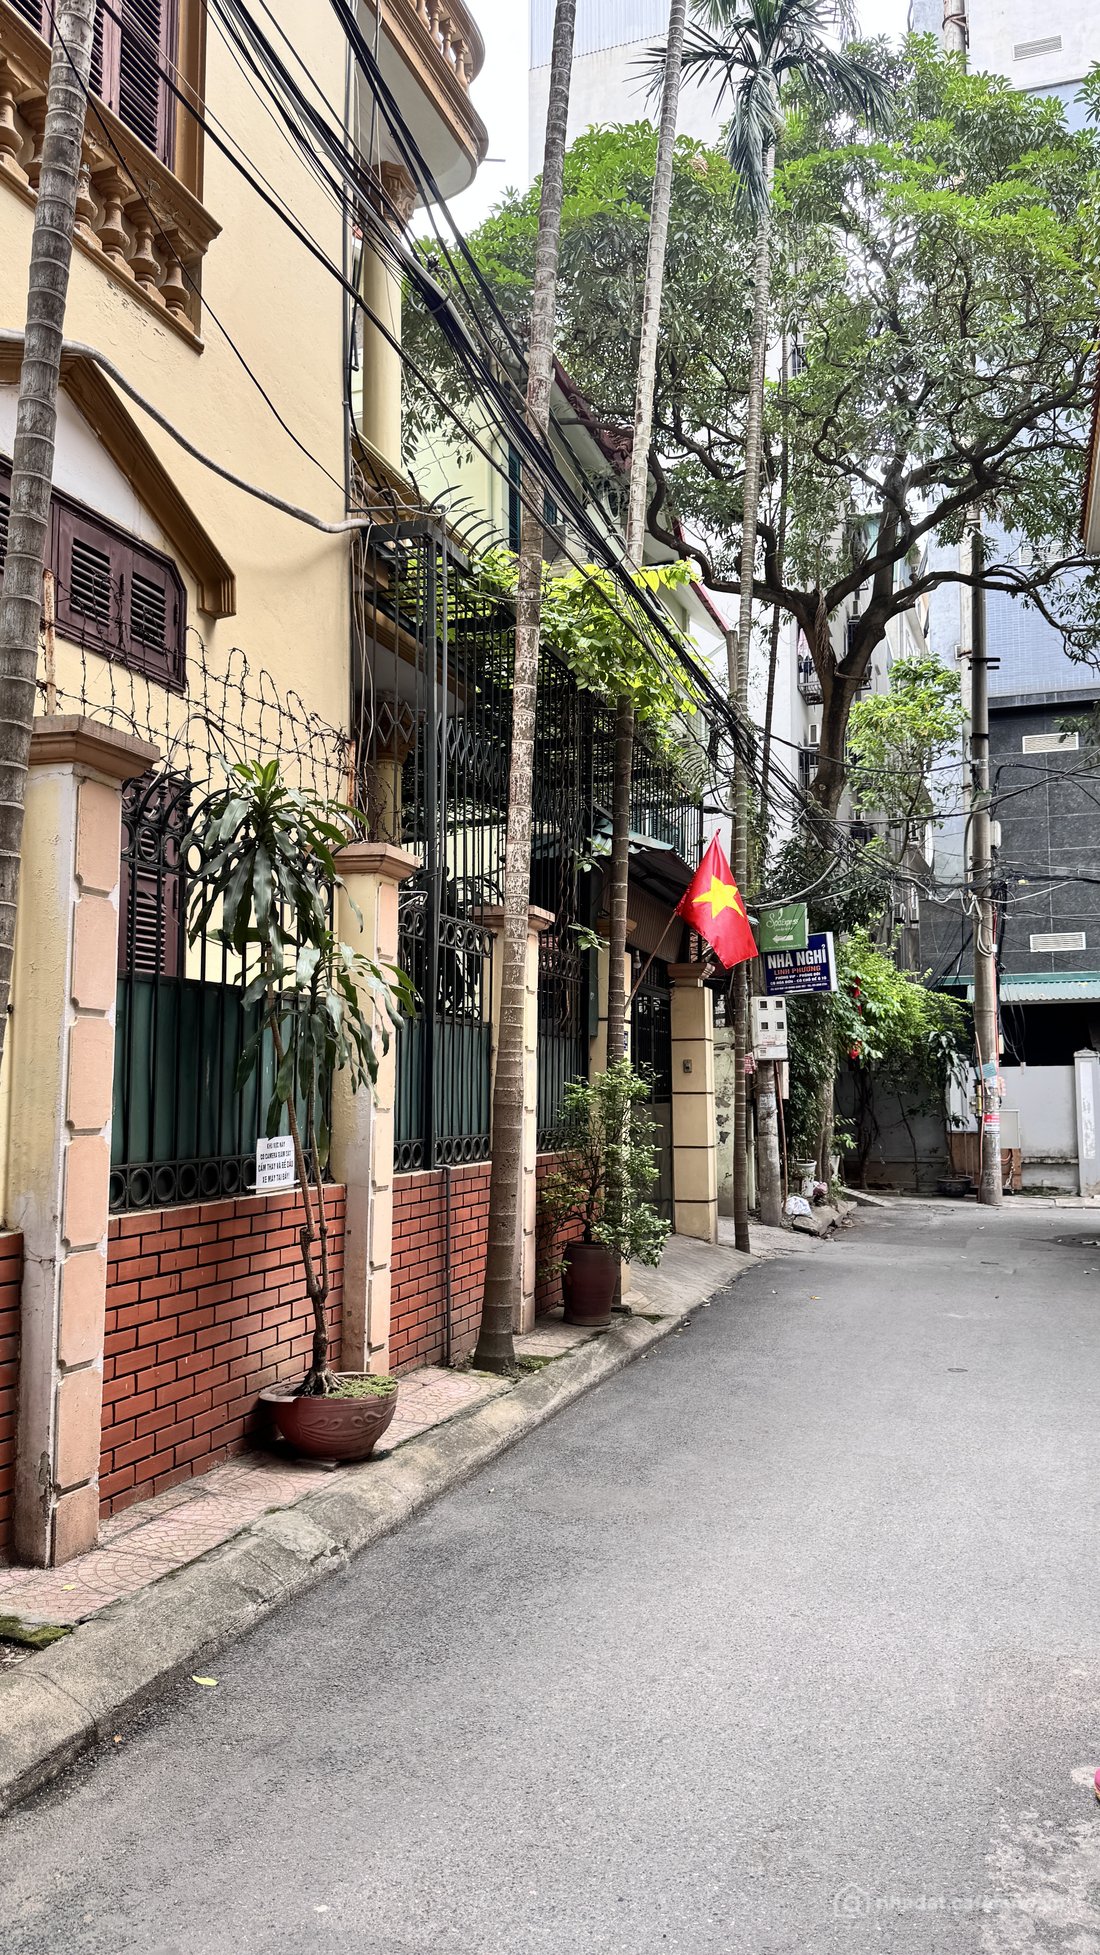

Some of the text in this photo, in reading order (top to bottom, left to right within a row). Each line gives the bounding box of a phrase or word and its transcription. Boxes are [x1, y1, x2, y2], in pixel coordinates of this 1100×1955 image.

[767, 944, 827, 969] NHÀ NGHỈ
[791, 965, 821, 974] PHƯƠNG
